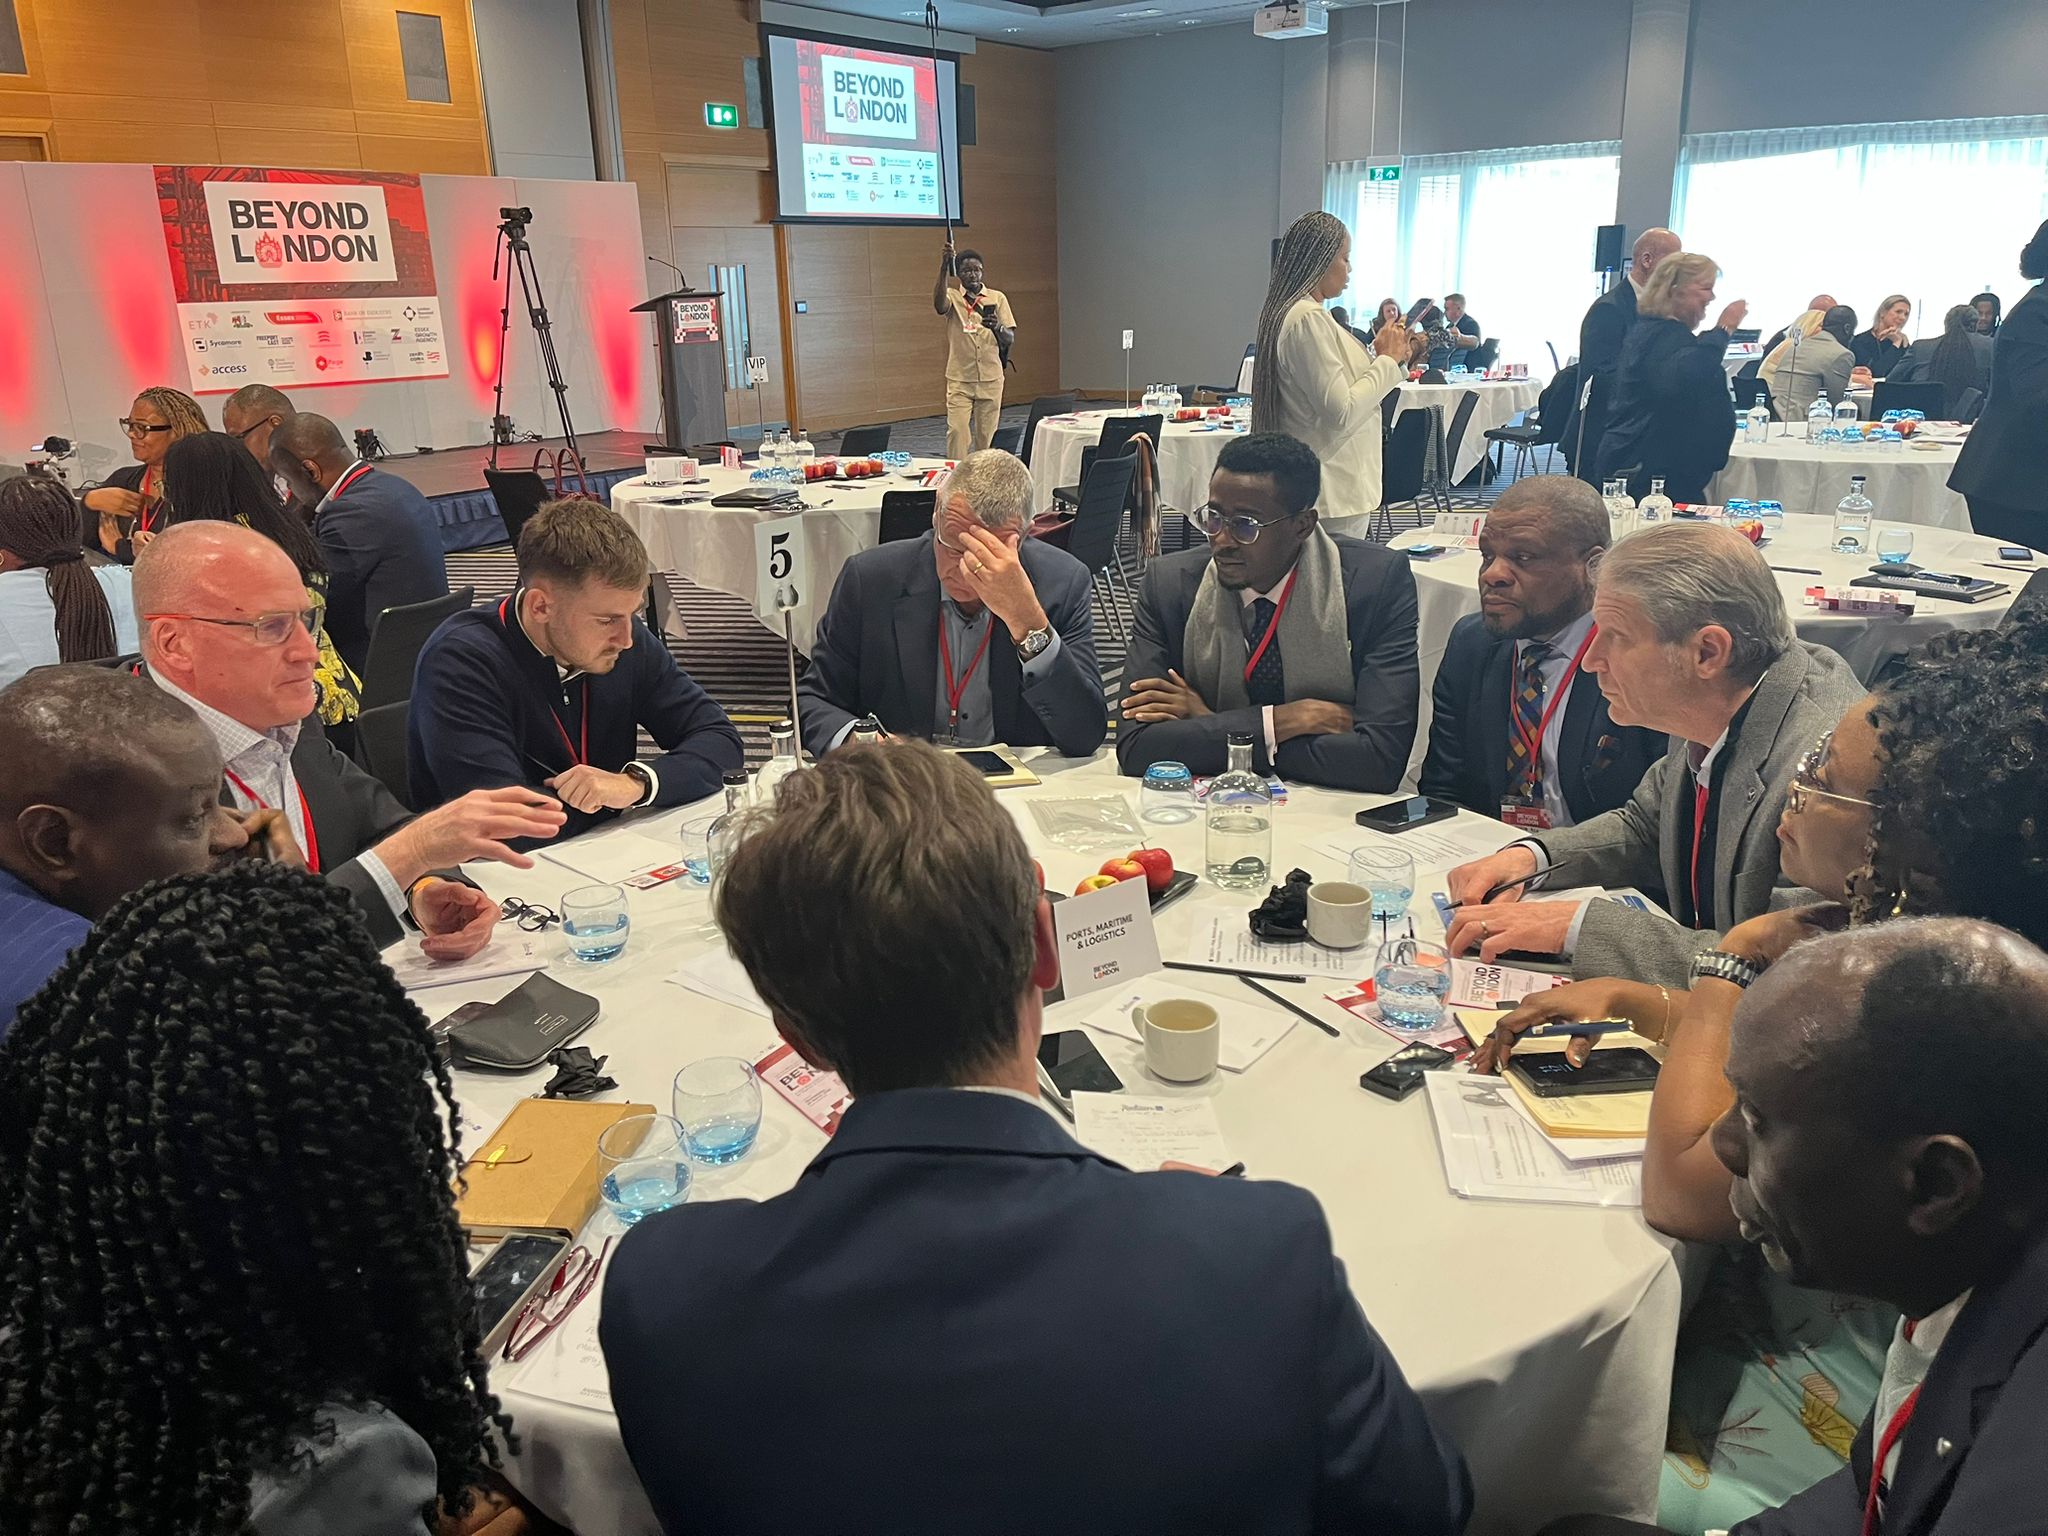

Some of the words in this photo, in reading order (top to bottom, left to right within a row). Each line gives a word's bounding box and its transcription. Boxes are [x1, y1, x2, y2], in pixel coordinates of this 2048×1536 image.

[834, 70, 904, 99] BEYOND
[834, 96, 907, 124] LONDON
[228, 199, 369, 230] BEYOND
[231, 233, 379, 267] LONDON
[680, 304, 709, 313] BEYOND
[680, 312, 710, 322] LONDON
[188, 320, 212, 330] ETK
[209, 339, 242, 348] Sycamore
[212, 364, 247, 374] access
[748, 357, 766, 369] VIP
[769, 531, 793, 579] 5
[1066, 926, 1095, 943] PORTS,
[1096, 914, 1133, 932] MARITIME
[1077, 940, 1085, 950] &
[1085, 927, 1126, 947] LOGISTICS
[1094, 961, 1118, 972] BEYOND
[1470, 967, 1487, 1002] BEYOND
[780, 1061, 811, 1086] BEY
[787, 1069, 822, 1092] LON
